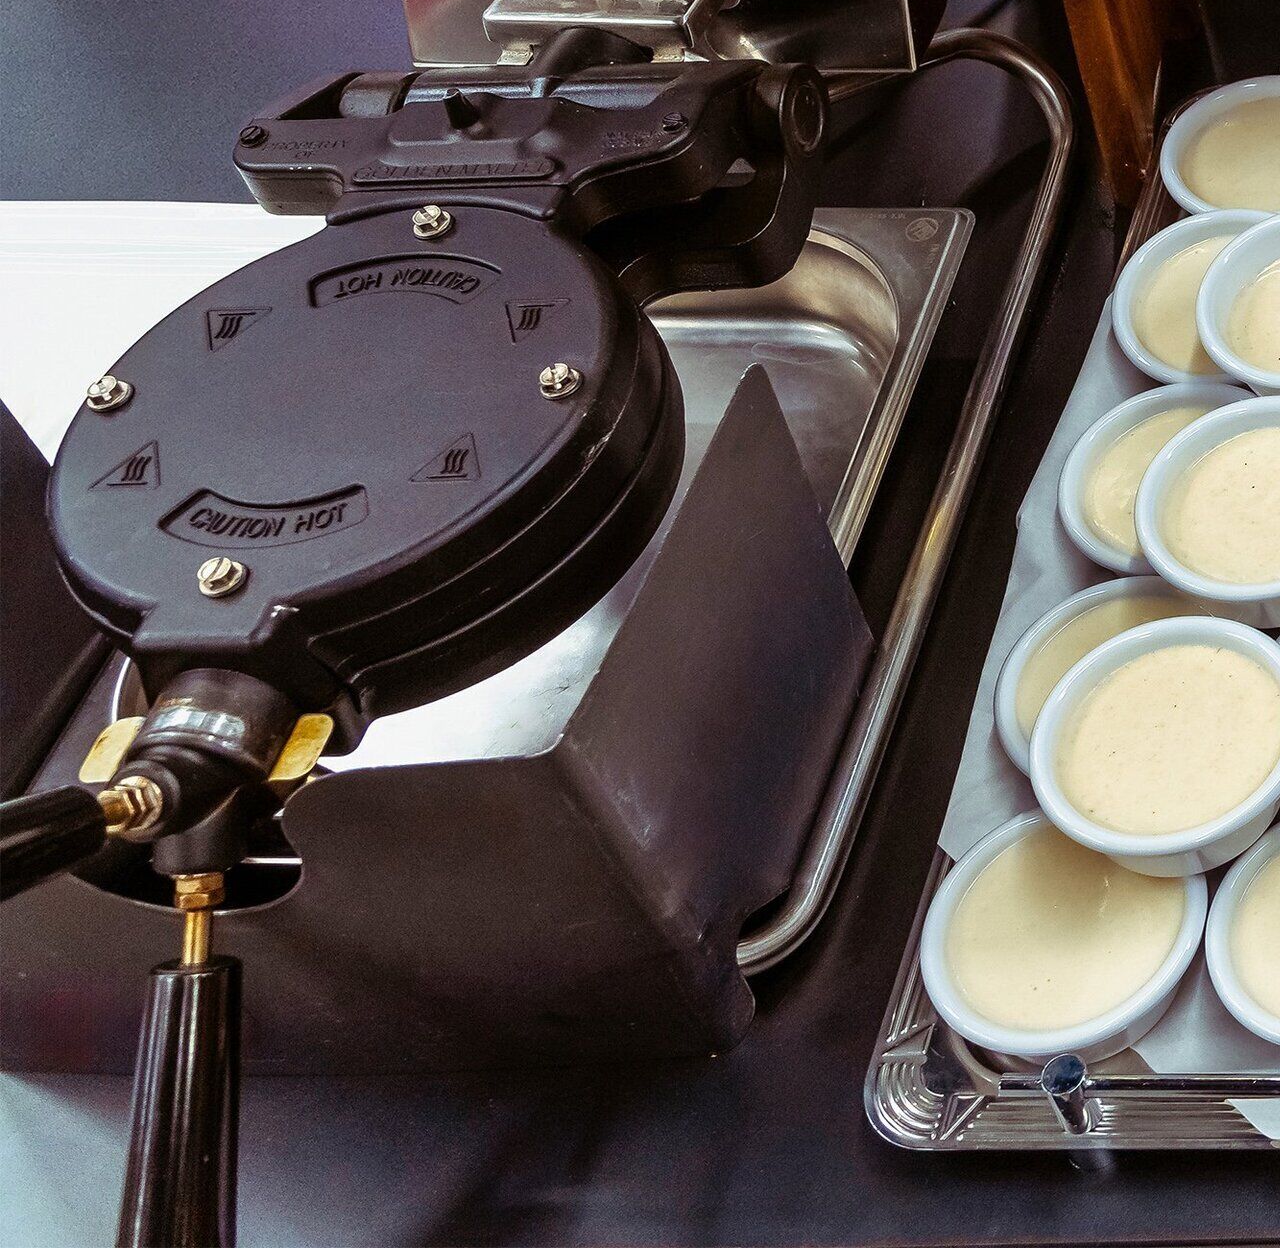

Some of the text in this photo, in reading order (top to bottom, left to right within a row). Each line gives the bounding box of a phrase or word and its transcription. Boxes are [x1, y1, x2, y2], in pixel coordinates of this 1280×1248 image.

[334, 267, 481, 299] CAUTION HOT
[189, 502, 349, 539] CAUTION HOT
